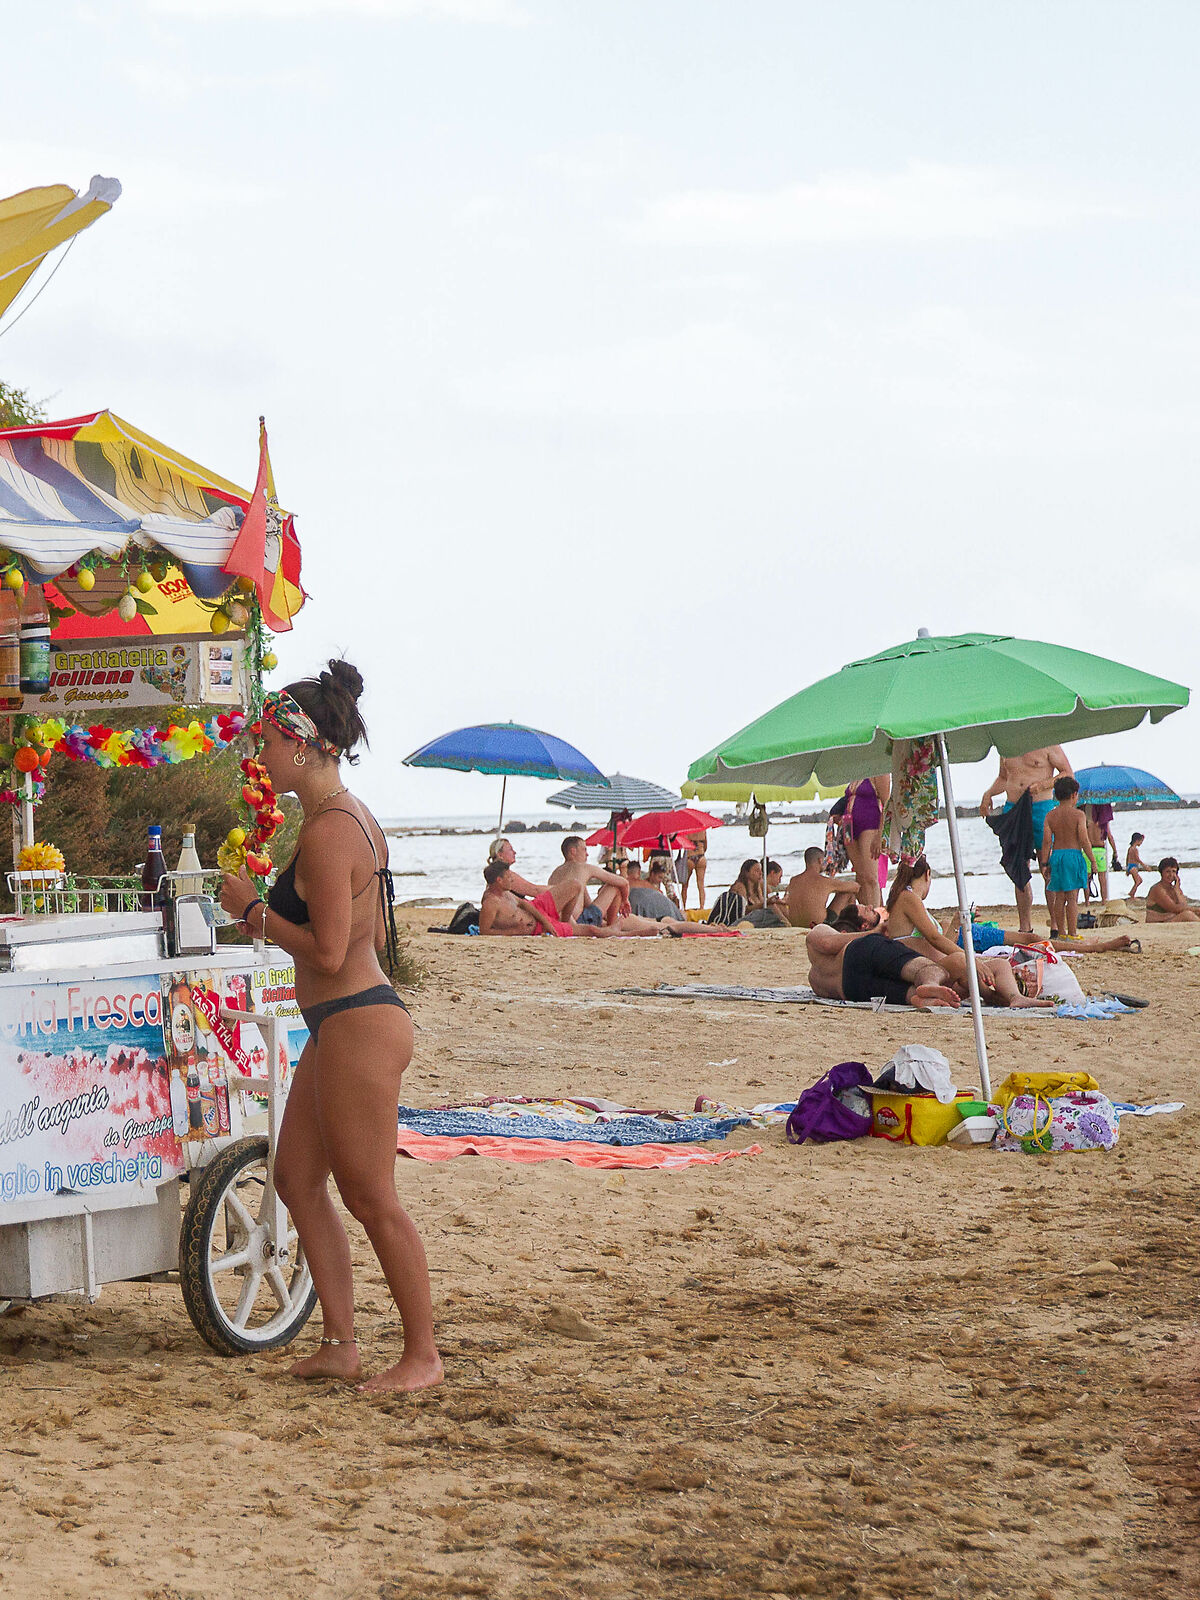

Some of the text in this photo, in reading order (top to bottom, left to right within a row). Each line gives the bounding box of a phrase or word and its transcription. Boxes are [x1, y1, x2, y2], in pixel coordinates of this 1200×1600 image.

[54, 648, 168, 670] Grattatella
[49, 669, 135, 687] iciliana
[40, 688, 129, 706] da Giuseppe
[253, 970, 266, 988] La
[67, 987, 162, 1034] Fresca
[191, 990, 218, 1027] TASTE
[103, 1113, 174, 1149] da Giuseppe
[44, 1160, 62, 1193] in
[67, 1151, 162, 1189] vaschetta
